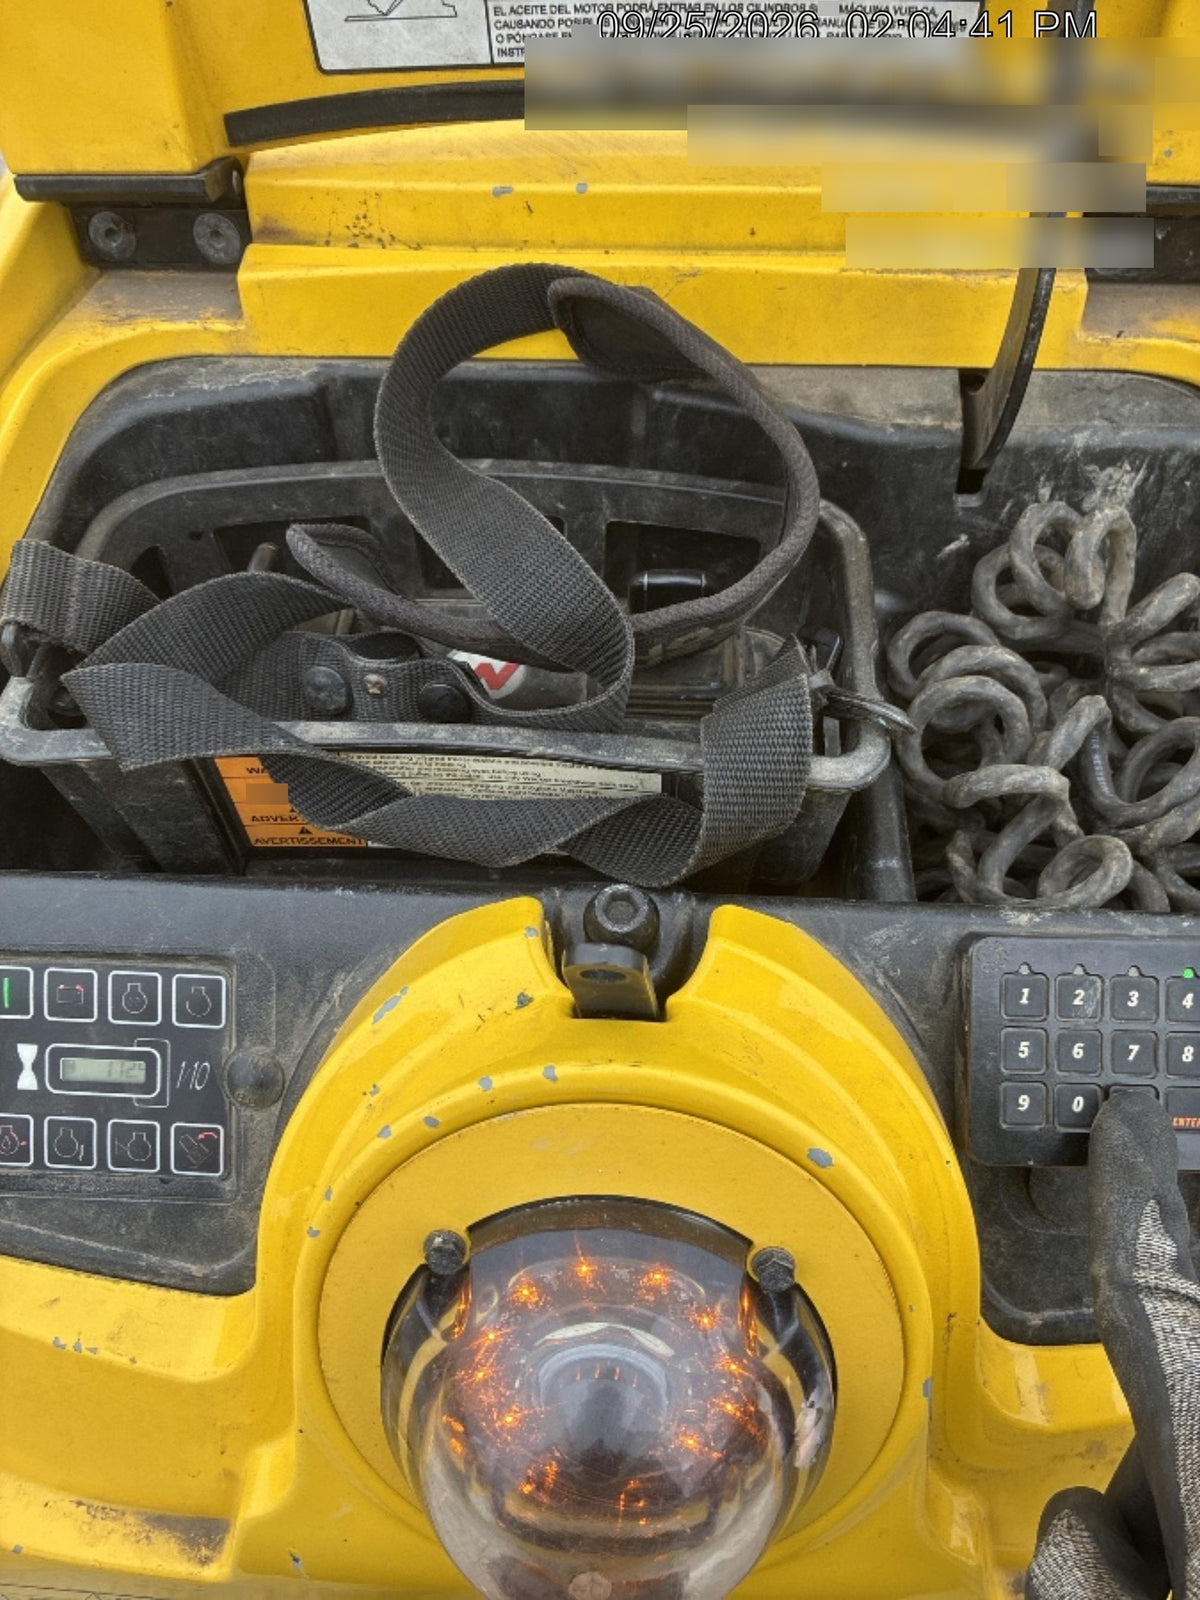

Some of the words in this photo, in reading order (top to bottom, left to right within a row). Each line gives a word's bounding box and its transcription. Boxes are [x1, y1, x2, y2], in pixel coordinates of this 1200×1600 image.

[494, 7, 507, 16] EL
[509, 5, 547, 15] ACEITE
[549, 4, 571, 14] DEL
[574, 3, 614, 14] MOTOR
[494, 19, 555, 31] CAUSANDO
[254, 836, 366, 846] AVERTISSEMENT
[1019, 988, 1030, 1005] 1
[1072, 989, 1085, 1006] 2
[1127, 991, 1139, 1007] 3
[1182, 993, 1194, 1009] 4
[1018, 1042, 1030, 1059] 5
[1072, 1043, 1085, 1059] 6
[1127, 1045, 1140, 1061] 7
[1182, 1046, 1194, 1063] 8
[1018, 1095, 1030, 1112] 9
[1072, 1096, 1084, 1113] 0
